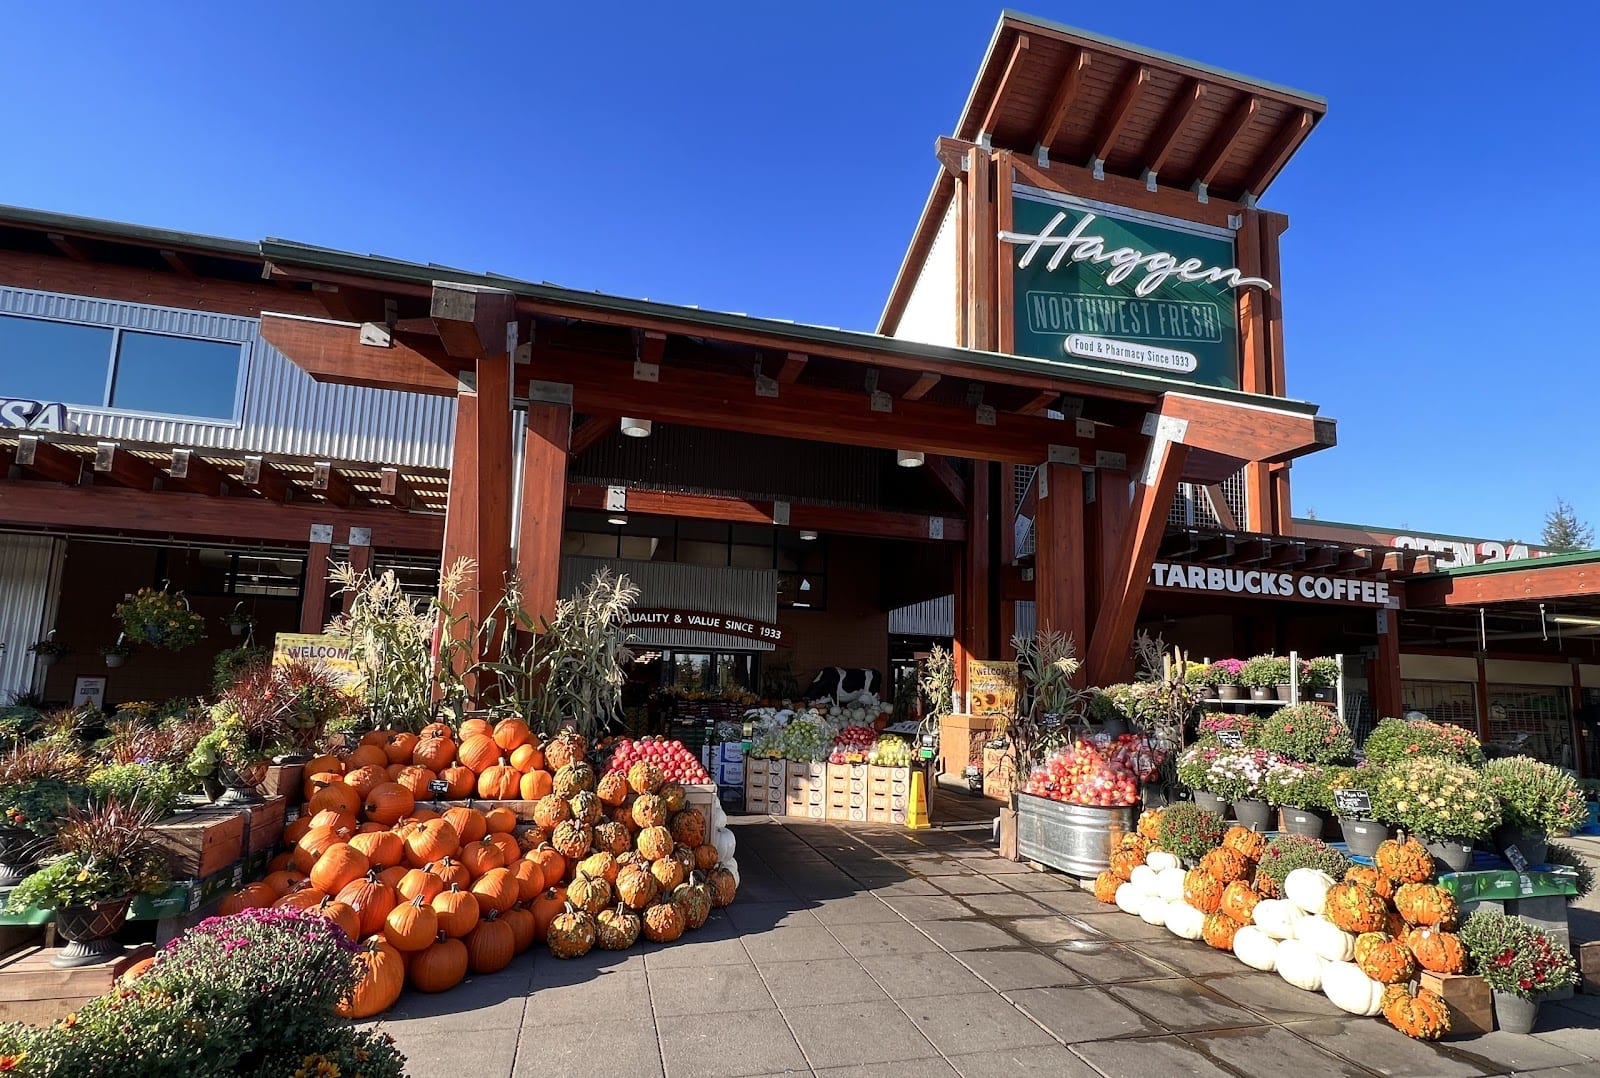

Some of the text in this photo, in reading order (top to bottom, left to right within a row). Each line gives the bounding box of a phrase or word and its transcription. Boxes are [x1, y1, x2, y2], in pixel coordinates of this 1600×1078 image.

[998, 212, 1272, 297] Haggen
[1033, 295, 1216, 338] NORTHWEST FRESH
[1075, 338, 1189, 368] Food & Pharmacy Since 1933
[1147, 562, 1390, 604] TARBUCKS COFFEE
[625, 613, 669, 624] QUALITY
[674, 614, 682, 624] &
[688, 615, 721, 628] VALUE
[725, 620, 754, 633] SINCE
[760, 626, 782, 640] 1933
